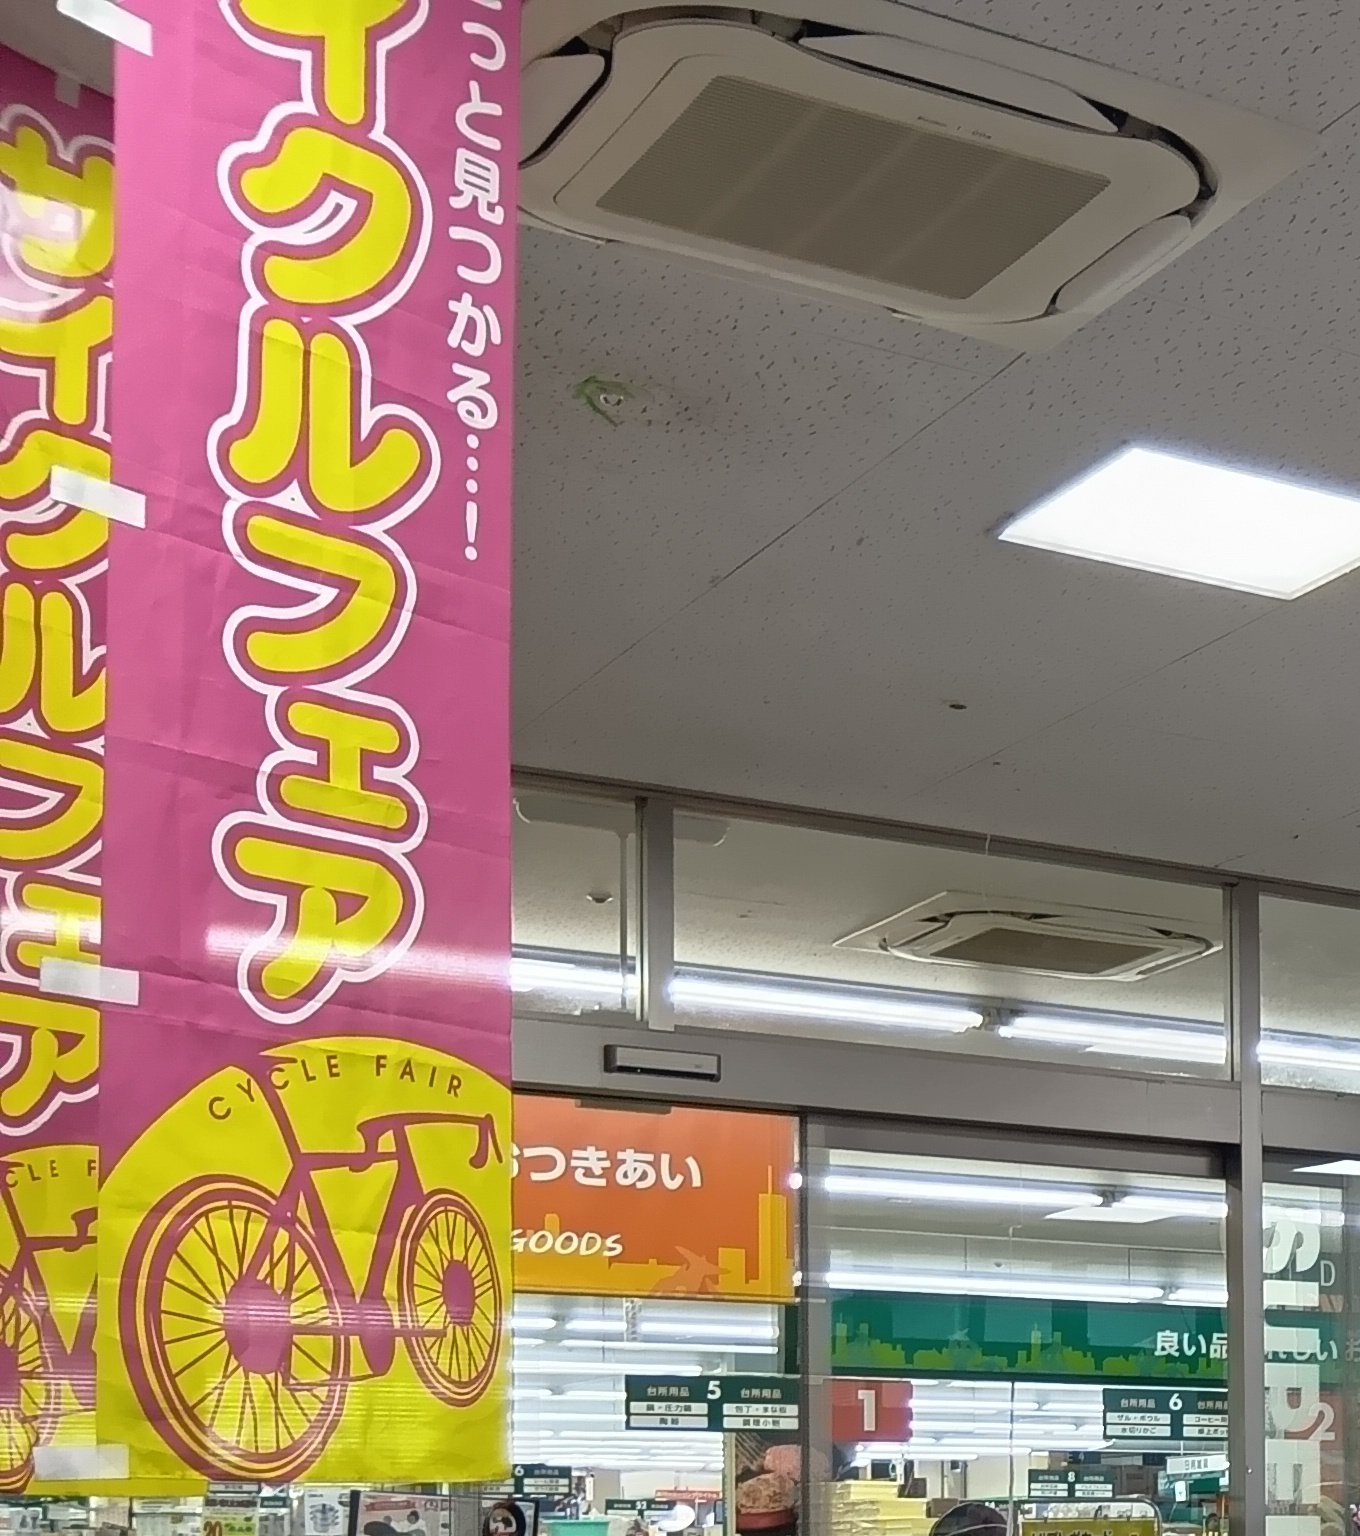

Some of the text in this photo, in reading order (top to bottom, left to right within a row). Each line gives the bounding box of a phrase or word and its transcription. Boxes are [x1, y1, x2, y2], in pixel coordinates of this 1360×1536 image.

[207, 1052, 463, 1123] CYCLE FAIR
[647, 1381, 782, 1399] 台所用品 5 台所用品
[1121, 1393, 1182, 1410] 台所用品 6
[857, 1390, 876, 1432] 1
[1067, 1472, 1075, 1482] 8
